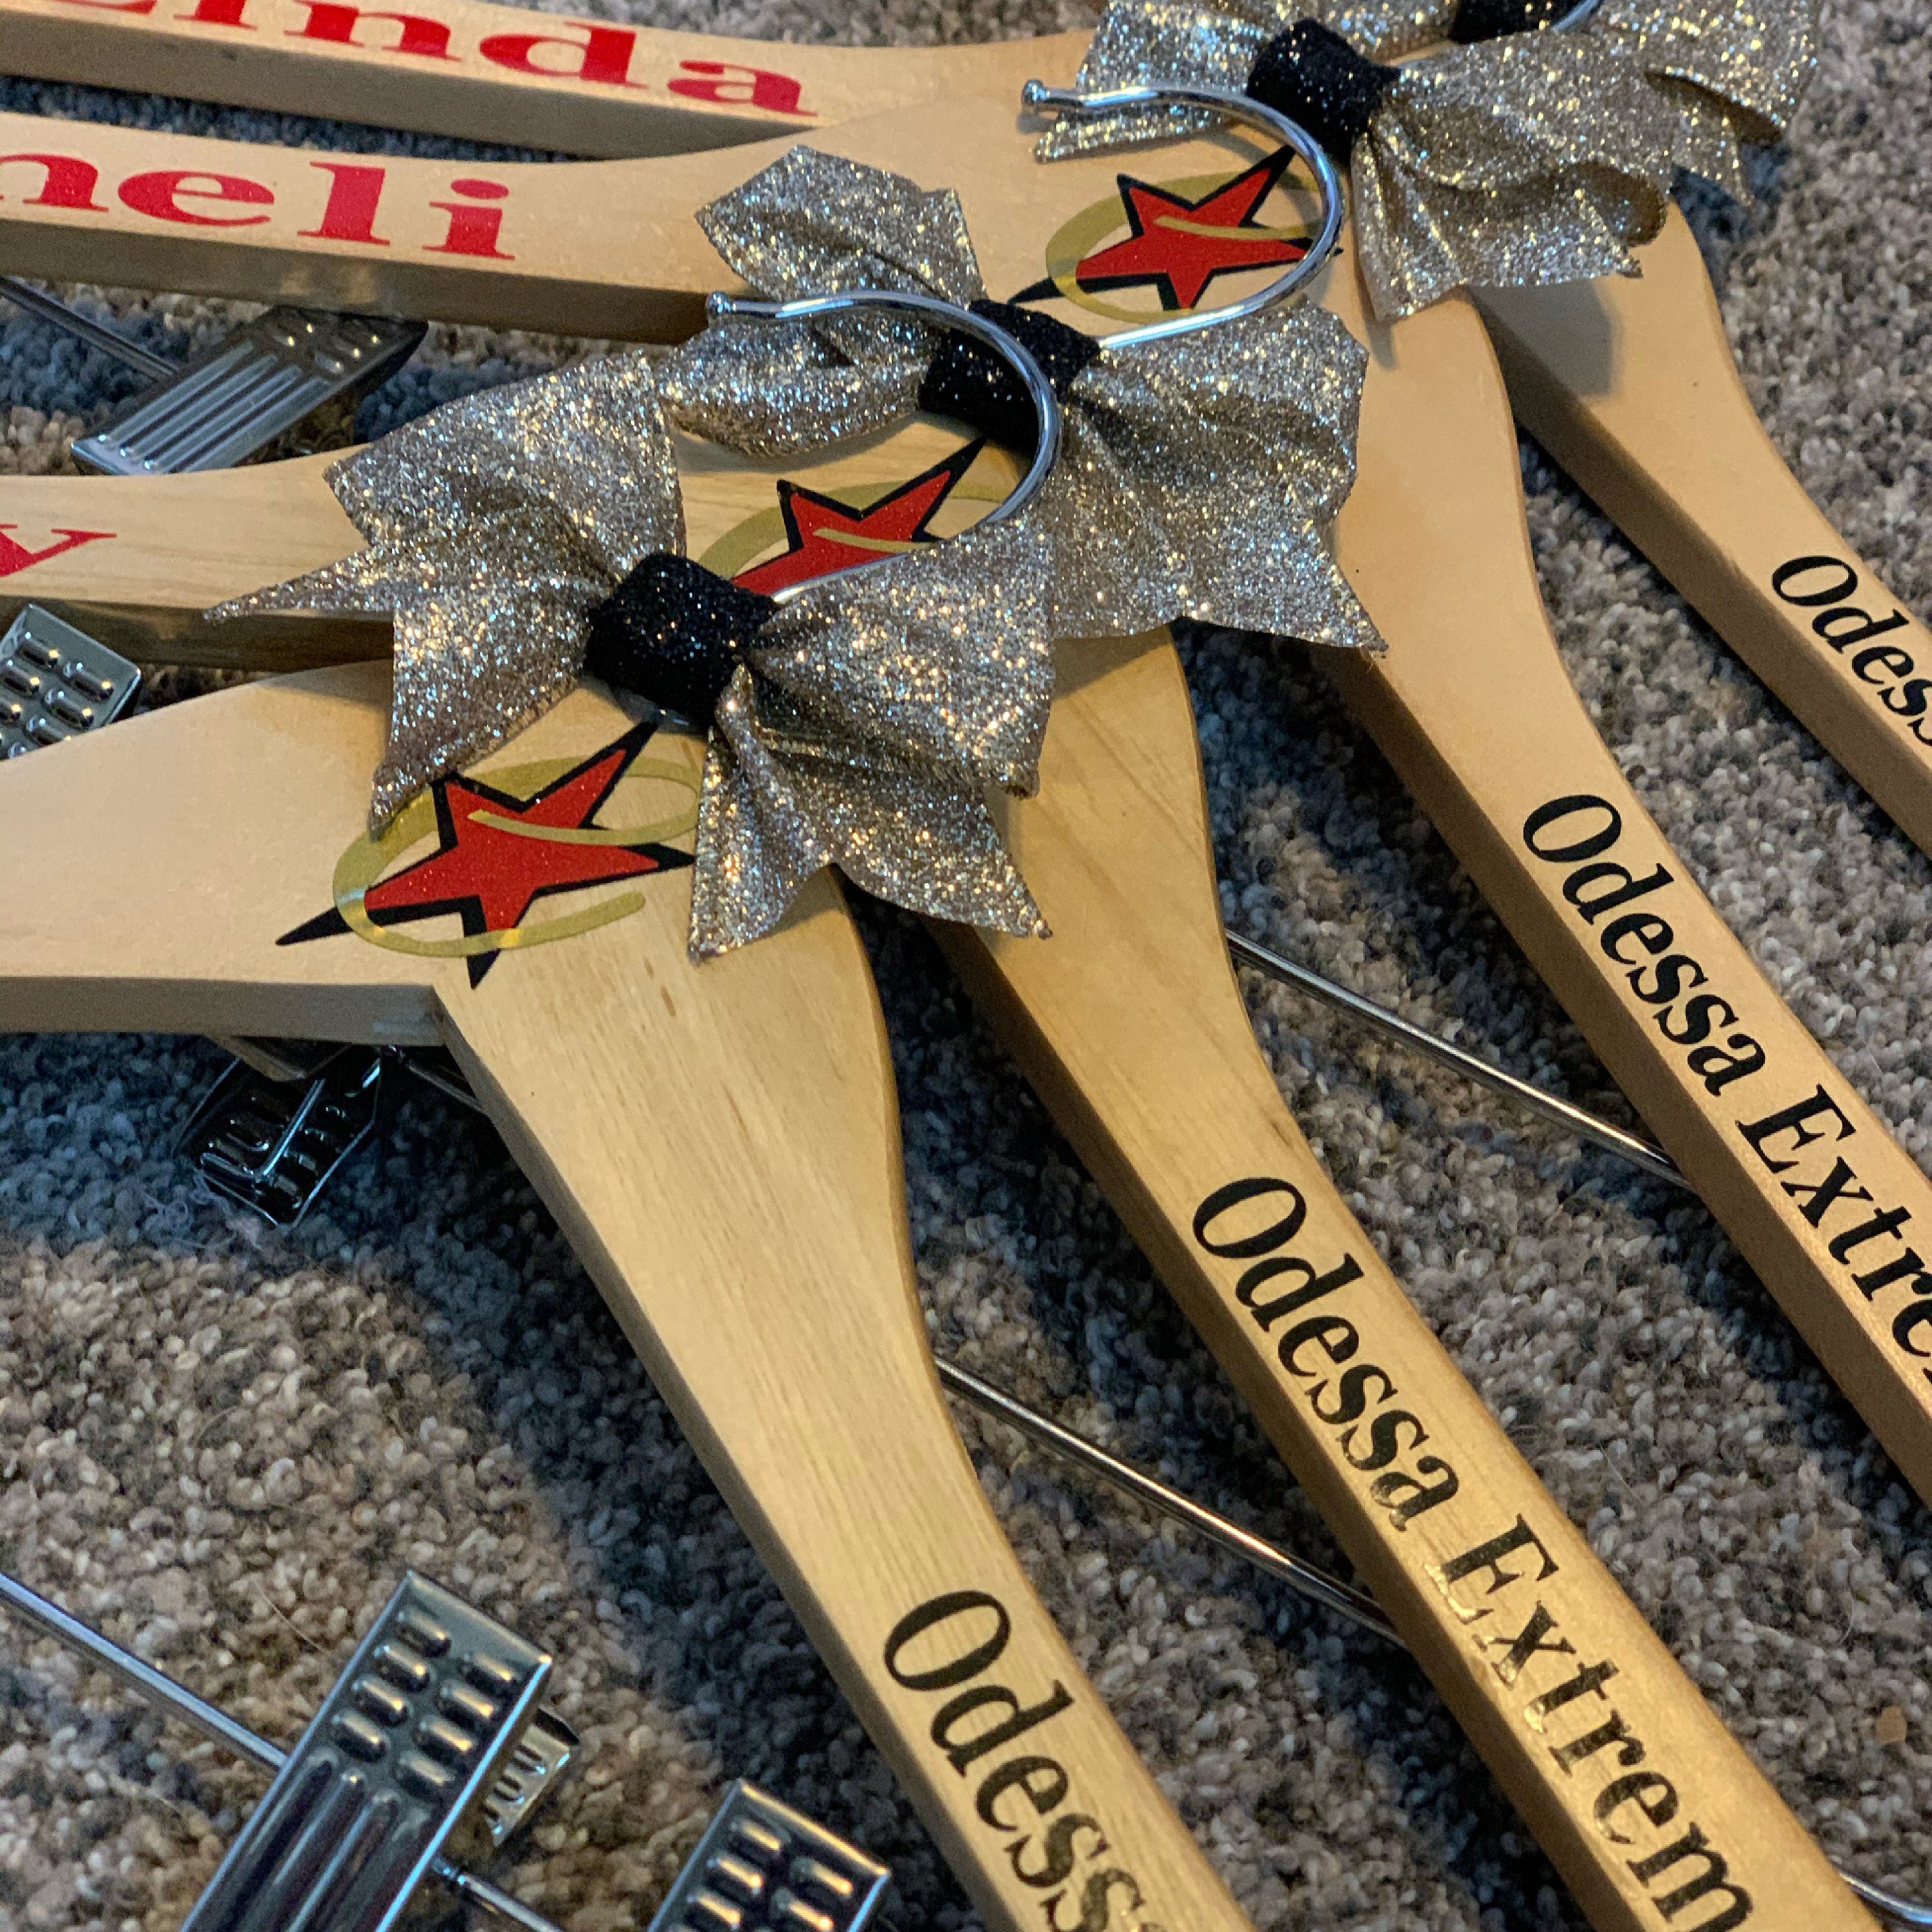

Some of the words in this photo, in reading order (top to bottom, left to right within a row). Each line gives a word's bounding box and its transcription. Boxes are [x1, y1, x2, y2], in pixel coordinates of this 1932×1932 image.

[1522, 794, 1766, 1097] Odessa
[1192, 1177, 1459, 1532] Odessa
[884, 1589, 1170, 1932] Odess
